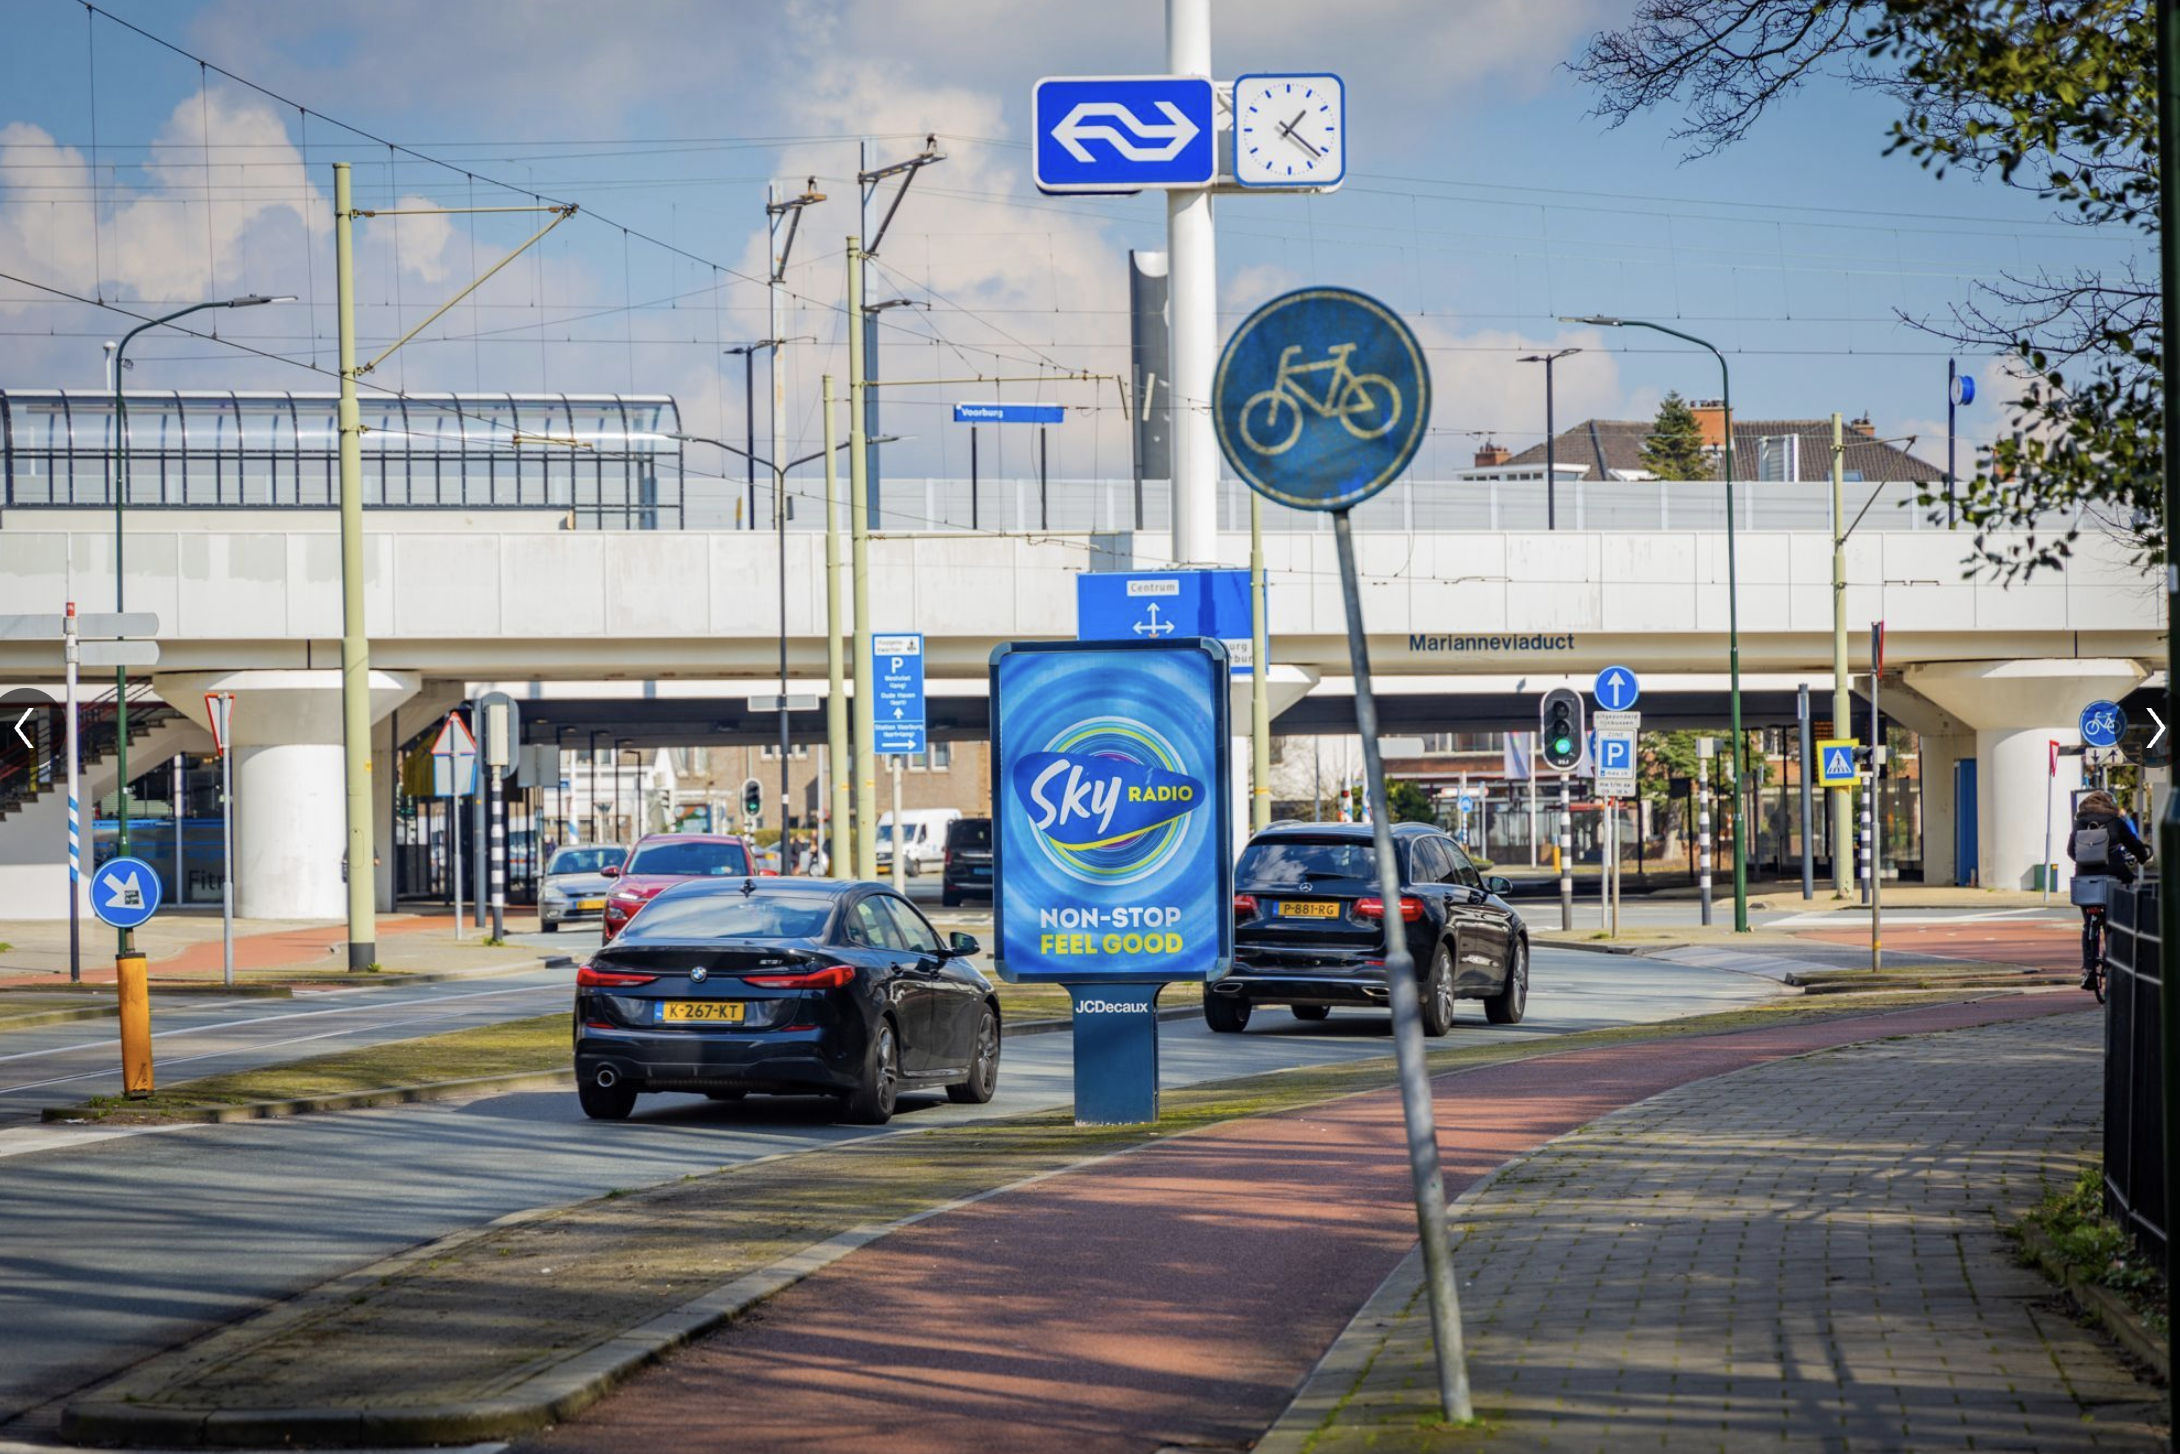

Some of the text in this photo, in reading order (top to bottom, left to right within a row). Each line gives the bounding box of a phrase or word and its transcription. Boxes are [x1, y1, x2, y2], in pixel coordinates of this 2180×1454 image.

[961, 408, 1003, 419] Voorburg
[1130, 583, 1175, 594] Centrum
[1409, 634, 1575, 651] Marianneviaduct
[892, 657, 904, 673] P
[1608, 743, 1624, 766] P
[1030, 759, 1193, 834] Sky RADIO
[1284, 903, 1334, 915] P-881-RG
[1040, 907, 1181, 928] NON-STOP
[1041, 933, 1183, 954] FEEL GOOD
[669, 1004, 738, 1018] K-267-KT
[1075, 1000, 1149, 1014] JCDecaux
